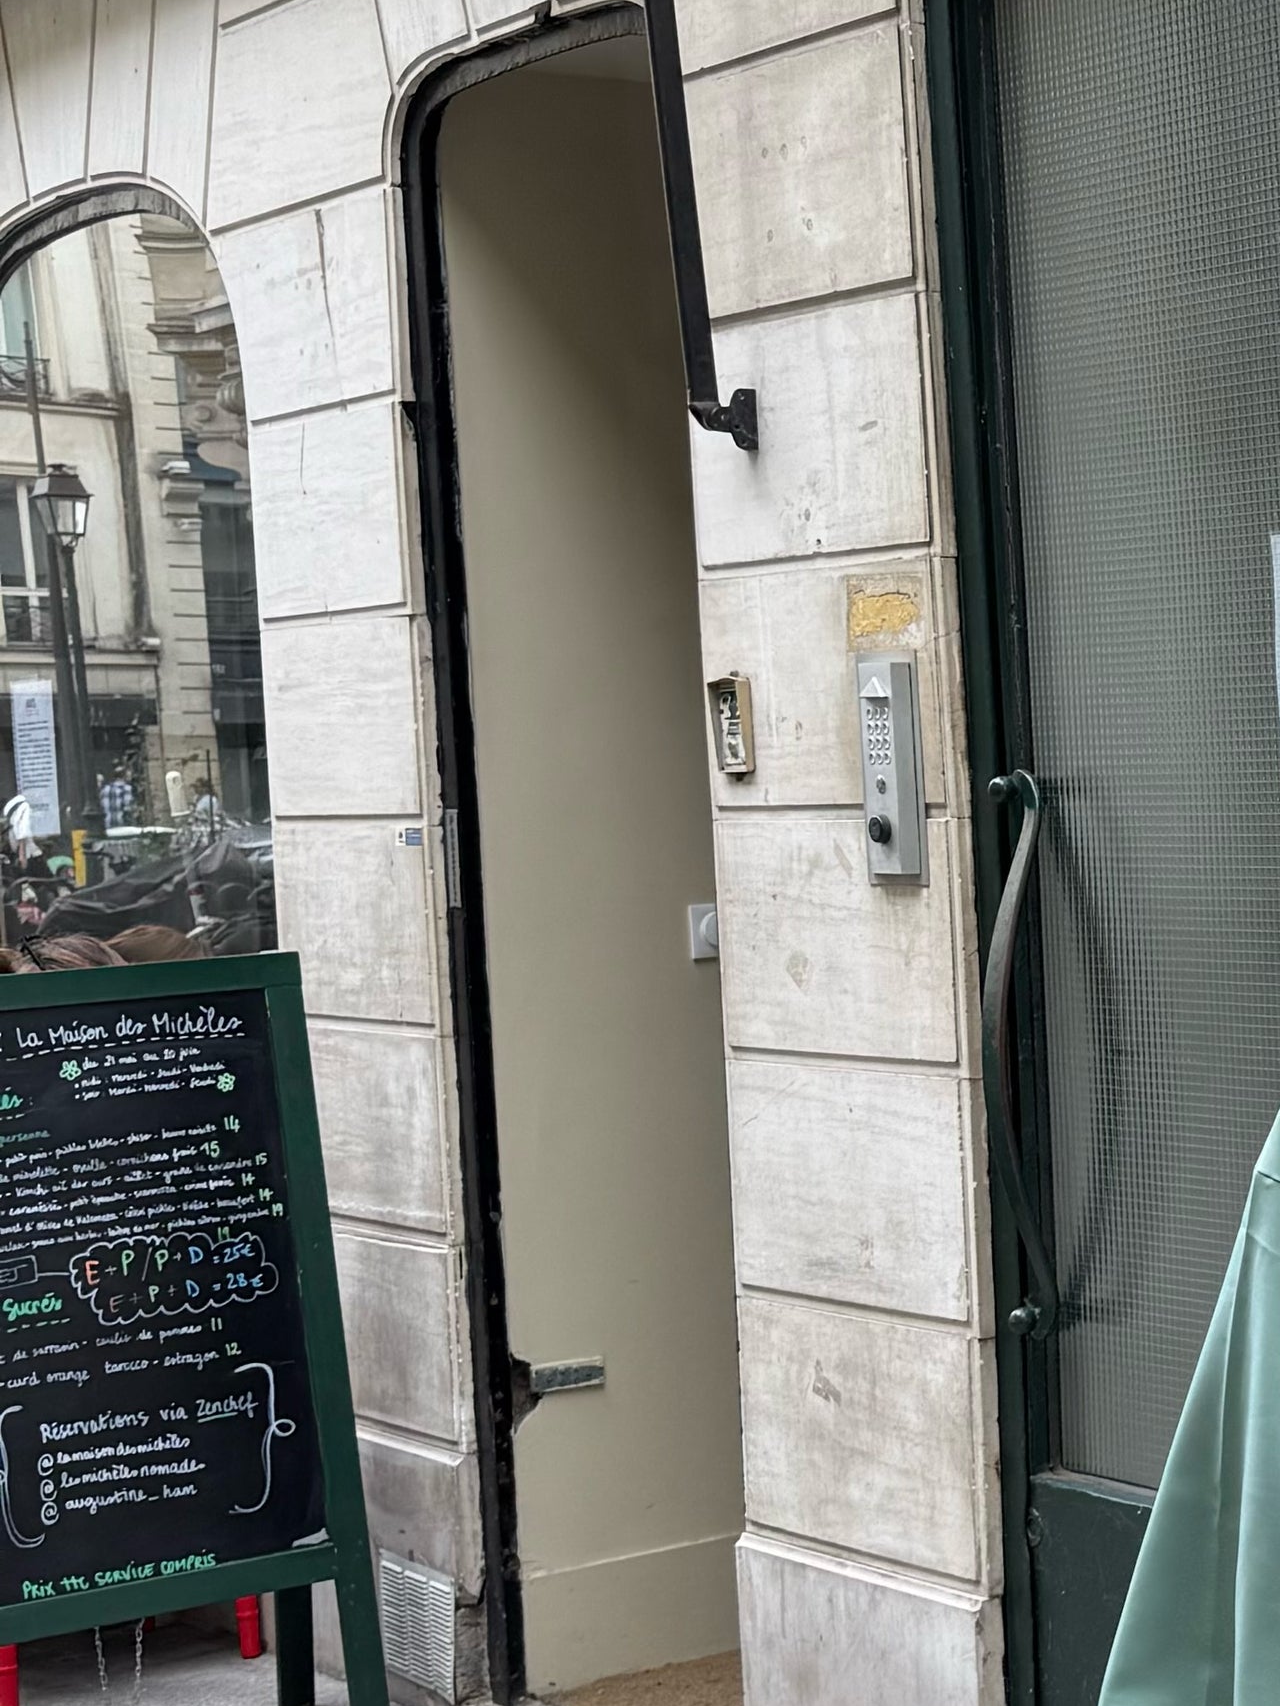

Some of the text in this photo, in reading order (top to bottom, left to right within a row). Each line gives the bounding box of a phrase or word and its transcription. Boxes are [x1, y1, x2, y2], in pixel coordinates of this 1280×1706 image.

[16, 1006, 242, 1048] La Maison des Michèles
[82, 1056, 99, 1070] du
[118, 1052, 137, 1064] mai
[143, 1052, 160, 1062] au
[179, 1047, 201, 1062] juin
[224, 1115, 240, 1133] 14
[200, 1140, 221, 1158] 15
[255, 1152, 268, 1165] 15
[241, 1172, 256, 1187] 14
[258, 1187, 274, 1202] 14
[85, 1260, 100, 1285] E
[121, 1249, 135, 1276] P
[154, 1249, 169, 1272] P
[188, 1246, 204, 1265] D
[223, 1243, 256, 1263] 25€
[109, 1294, 125, 1313] E
[149, 1285, 160, 1303] P
[185, 1279, 200, 1297] D
[225, 1272, 263, 1289] 28€
[7, 1371, 41, 1389] curd
[46, 1369, 90, 1388] orange
[163, 1350, 220, 1371] estragon
[225, 1342, 242, 1357] 12
[39, 1391, 259, 1443] Réservations via Zenchef
